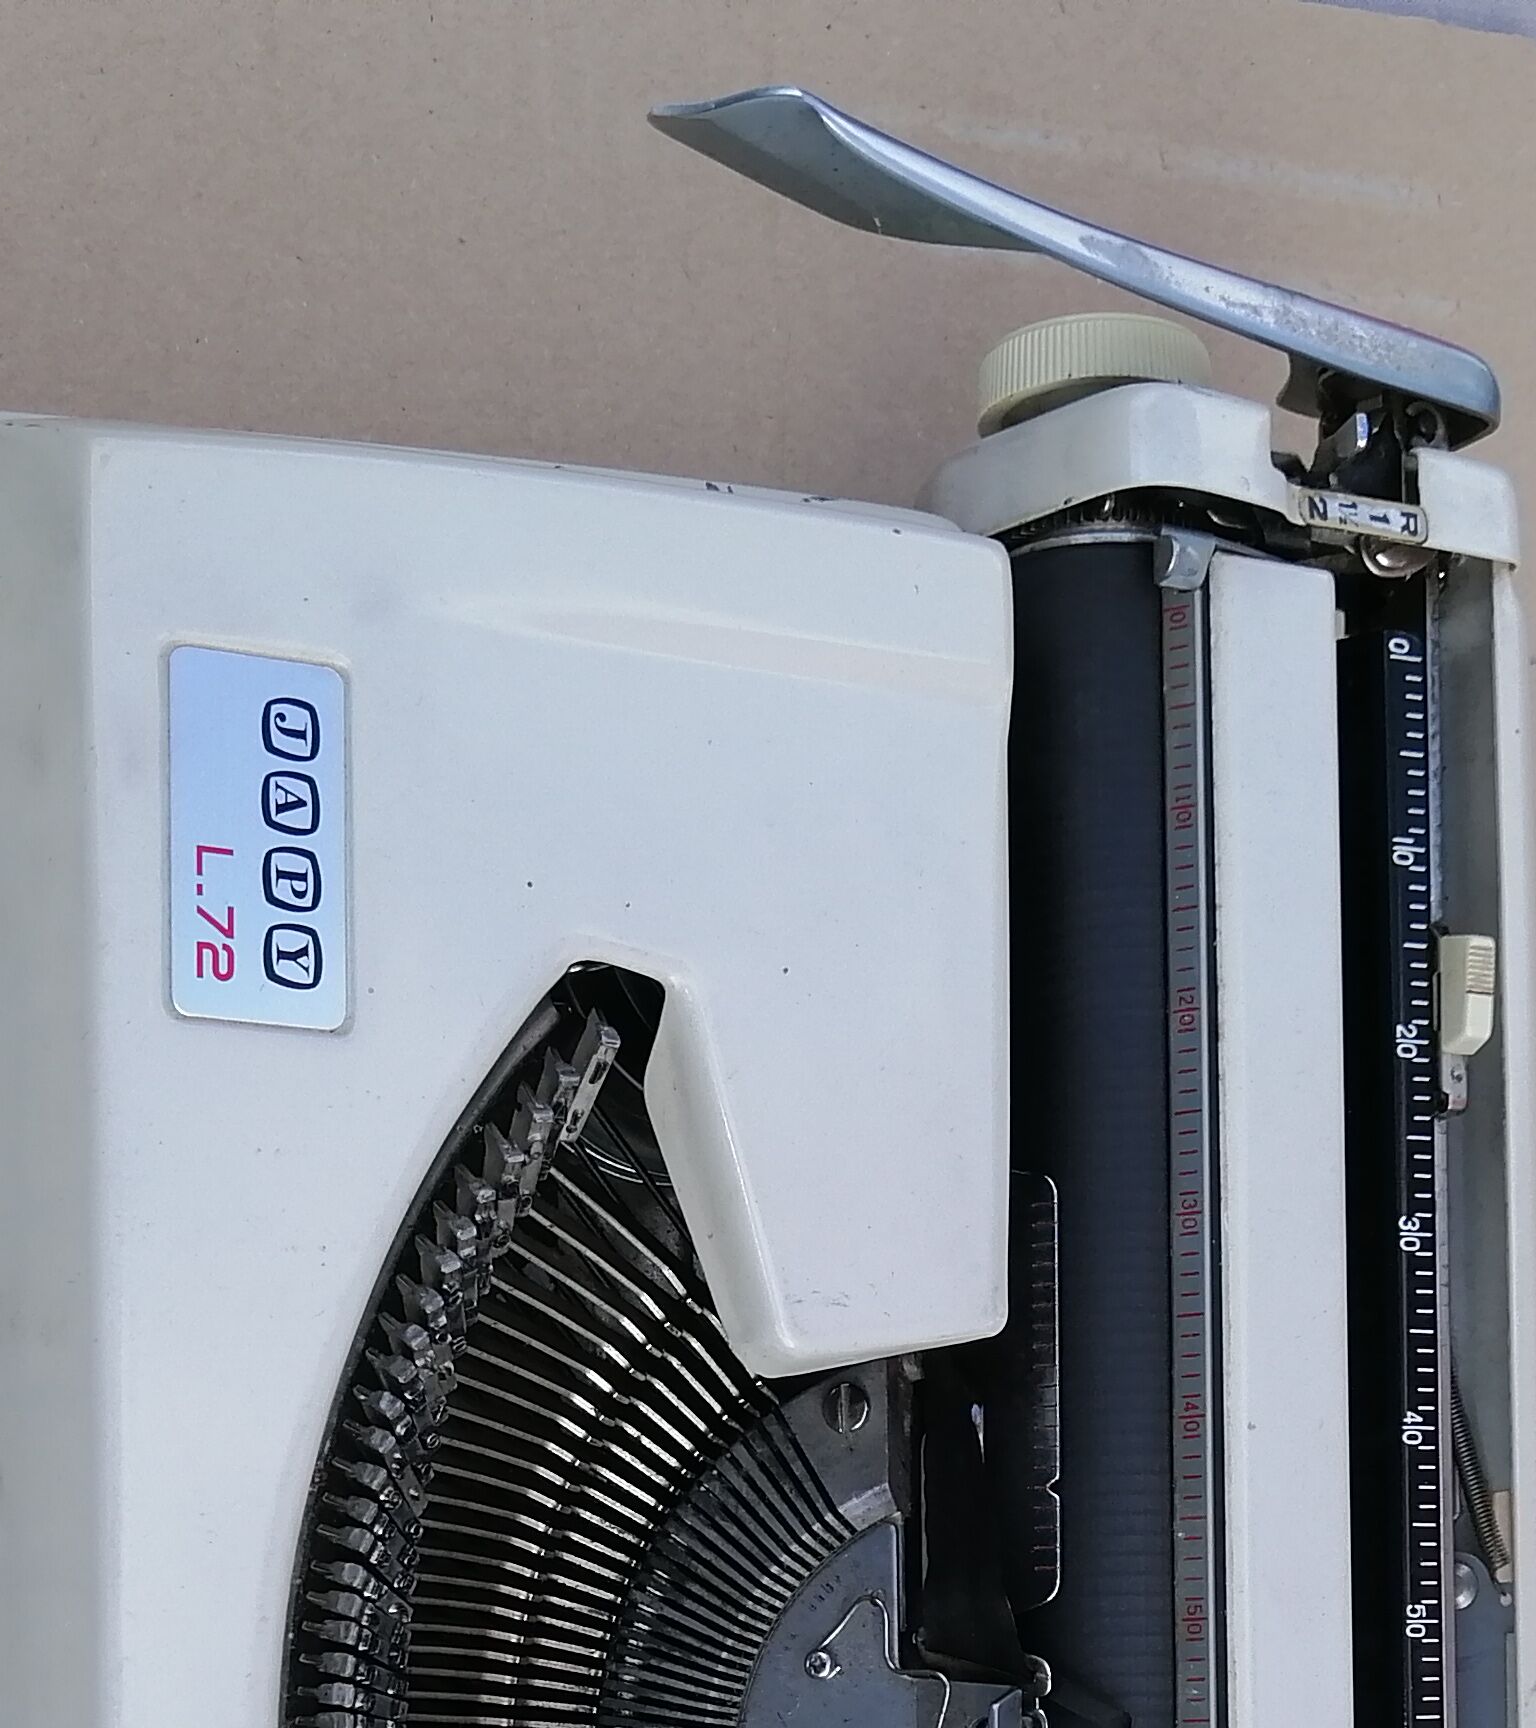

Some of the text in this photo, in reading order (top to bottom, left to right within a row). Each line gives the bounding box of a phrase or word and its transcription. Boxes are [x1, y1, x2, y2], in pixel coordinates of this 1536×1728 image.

[1308, 496, 1328, 522] 2
[1369, 512, 1391, 524] 1
[1400, 511, 1418, 537] R
[1168, 611, 1186, 625] 0
[1387, 637, 1410, 655] 0
[272, 710, 312, 979] JAPY
[1391, 836, 1417, 866] 10
[195, 844, 236, 983] L.72
[1396, 1023, 1419, 1058] 20
[1179, 1197, 1199, 1231] 30
[1396, 1216, 1422, 1252] 30
[1182, 1400, 1203, 1433] 40
[1400, 1411, 1424, 1445] 40
[1185, 1603, 1205, 1636] 50
[1404, 1604, 1427, 1639] 50
